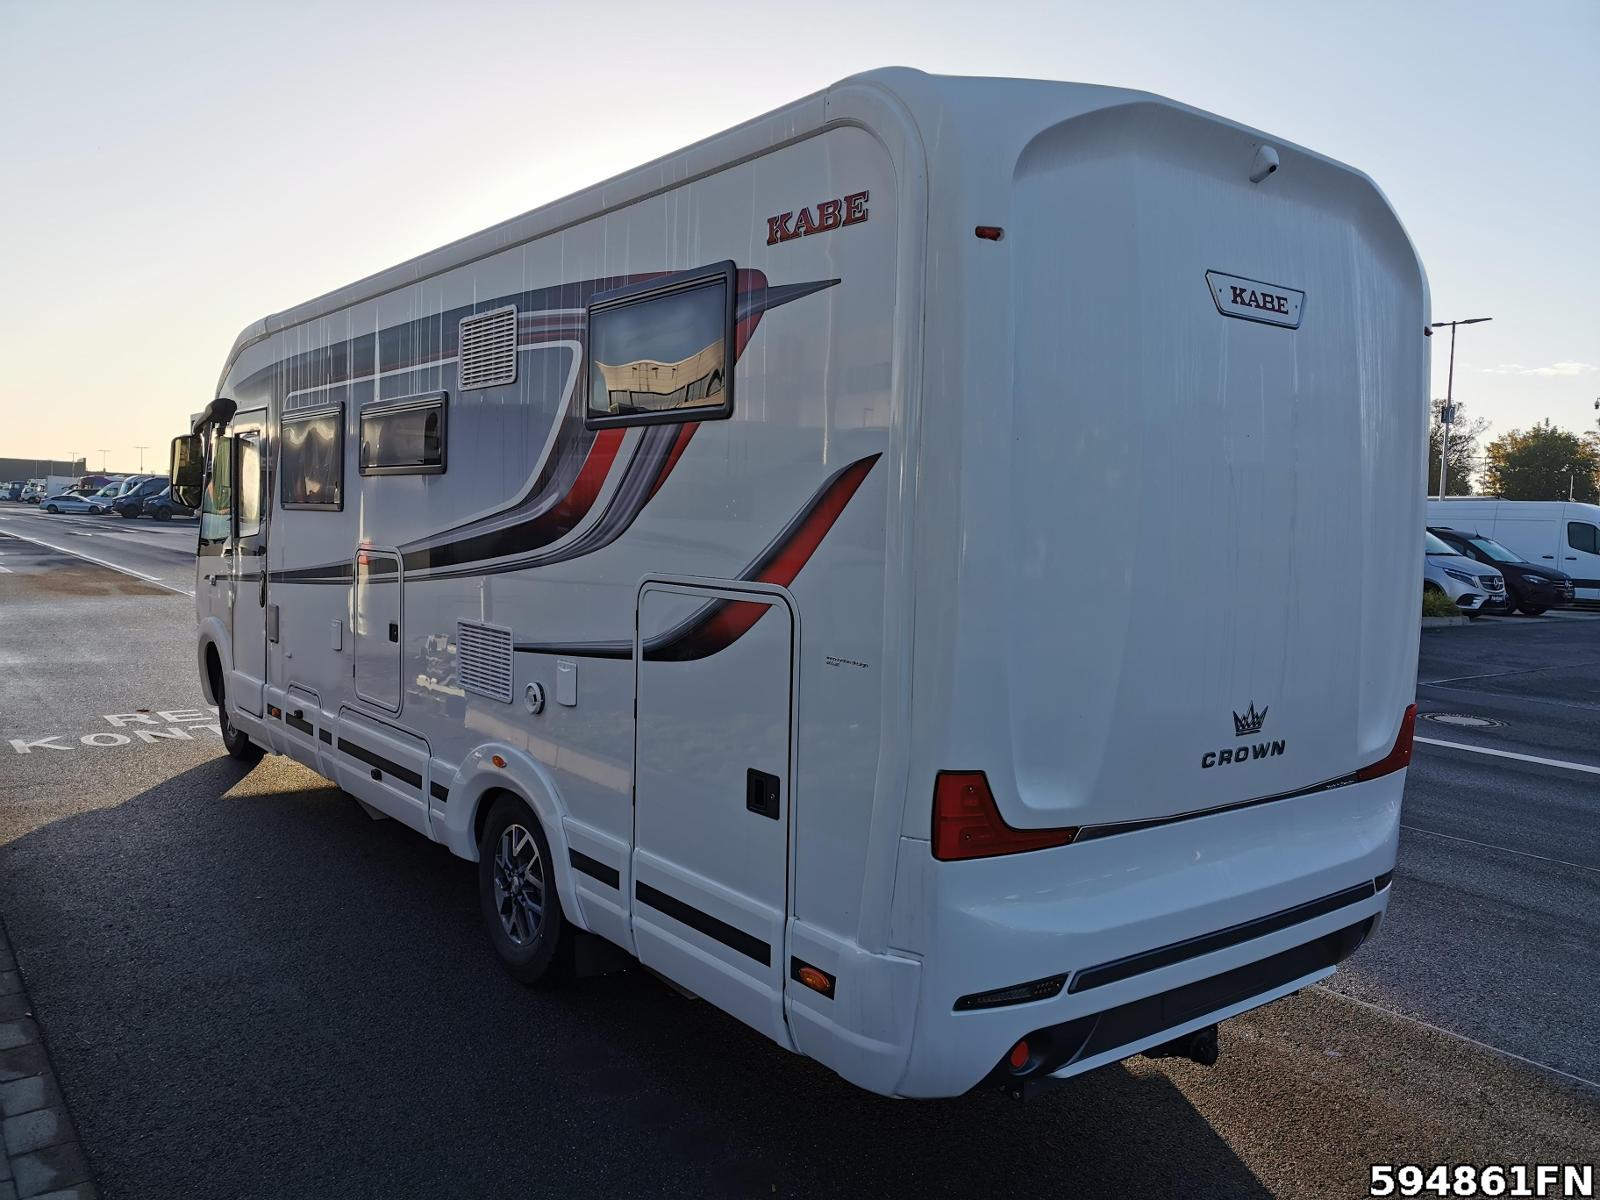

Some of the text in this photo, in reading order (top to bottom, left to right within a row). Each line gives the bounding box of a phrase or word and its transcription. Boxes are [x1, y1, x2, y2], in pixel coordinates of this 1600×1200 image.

[767, 190, 869, 245] KABE
[1230, 285, 1289, 315] KABE
[103, 707, 220, 727] RE
[1202, 740, 1286, 768] CROWN
